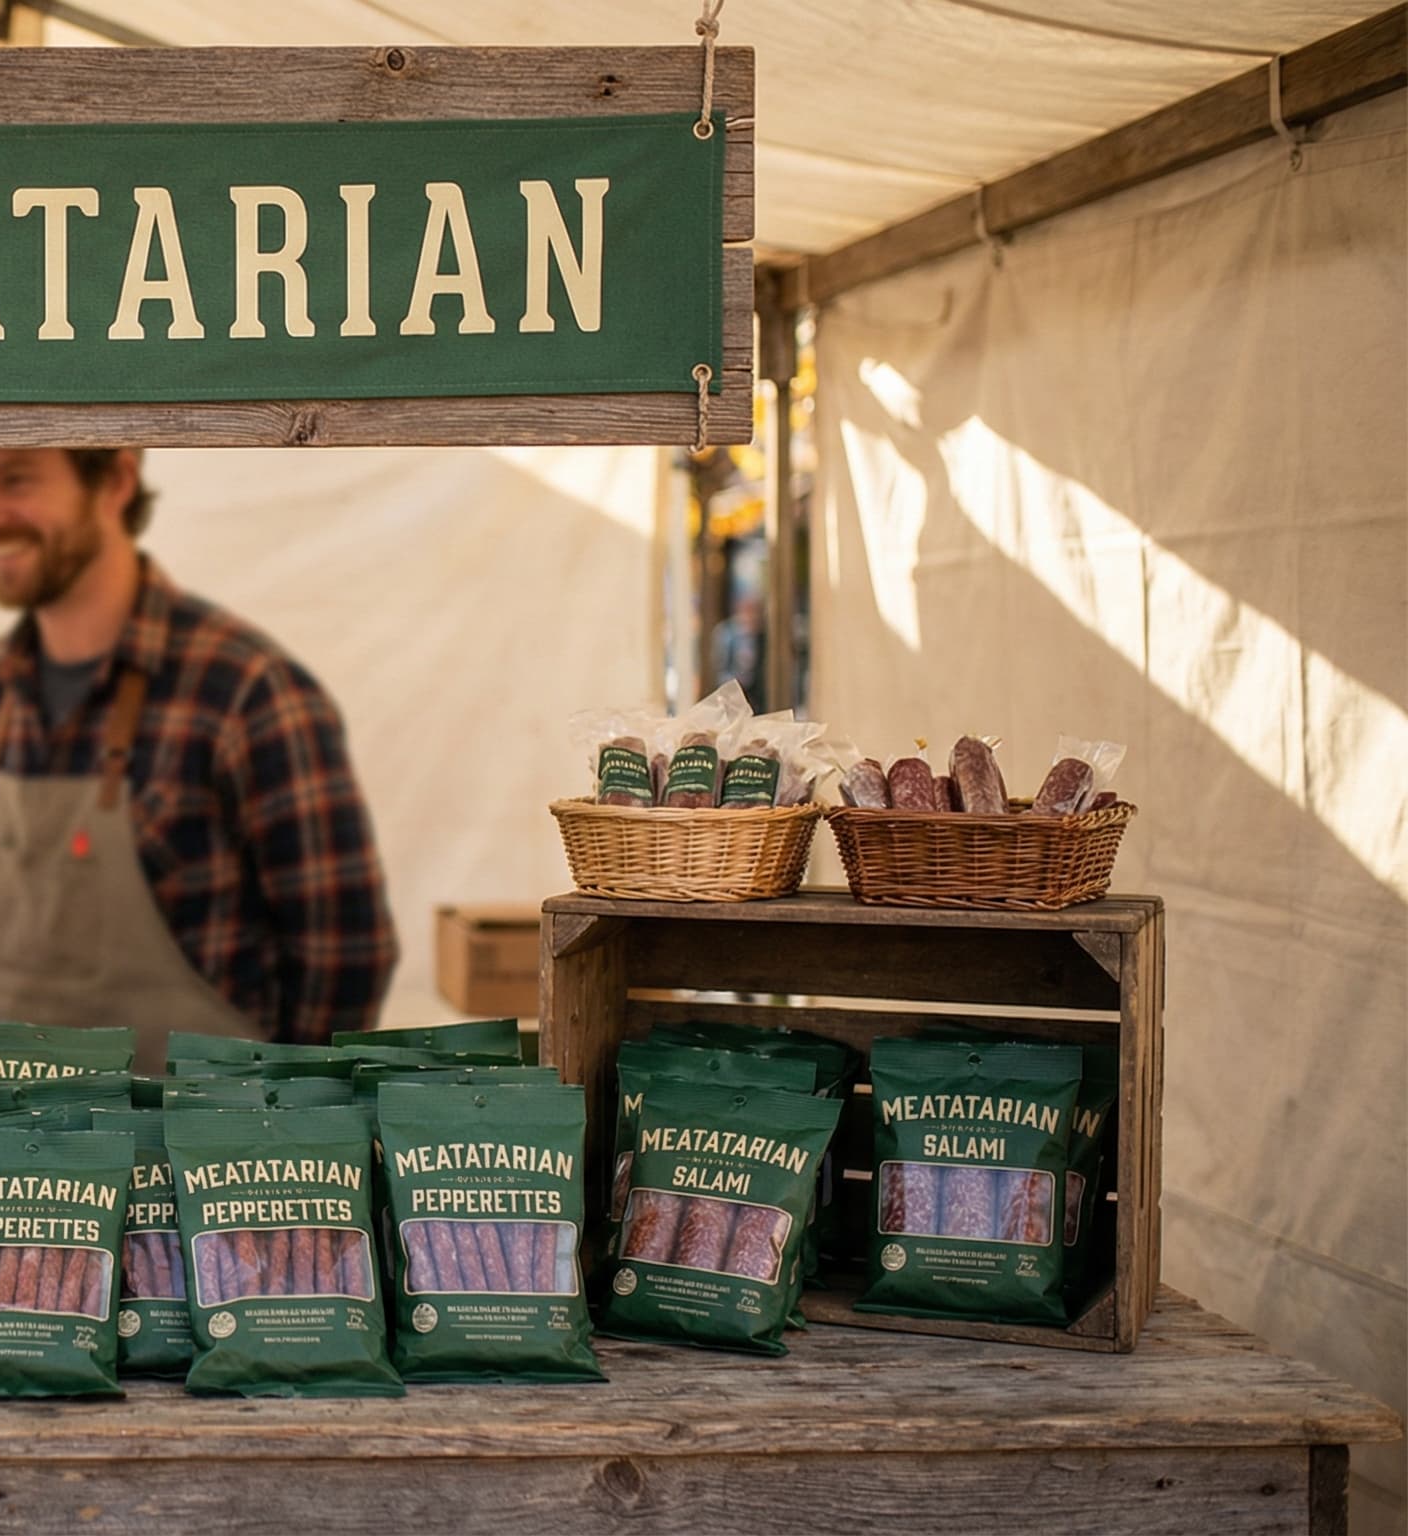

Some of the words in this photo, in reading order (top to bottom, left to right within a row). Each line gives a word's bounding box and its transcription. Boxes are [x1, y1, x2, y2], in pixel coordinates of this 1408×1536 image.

[882, 1094, 1060, 1135] MEATATARIAN
[395, 1143, 573, 1181] MEATATARIAN
[640, 1128, 809, 1175] MEATATARIAN
[923, 1133, 1006, 1161] SALAMI
[184, 1159, 362, 1194] MEATATARIAN
[672, 1165, 752, 1196] SALAMI
[202, 1199, 353, 1225] PEPPERETTES
[412, 1188, 561, 1214] PEPPERETTES
